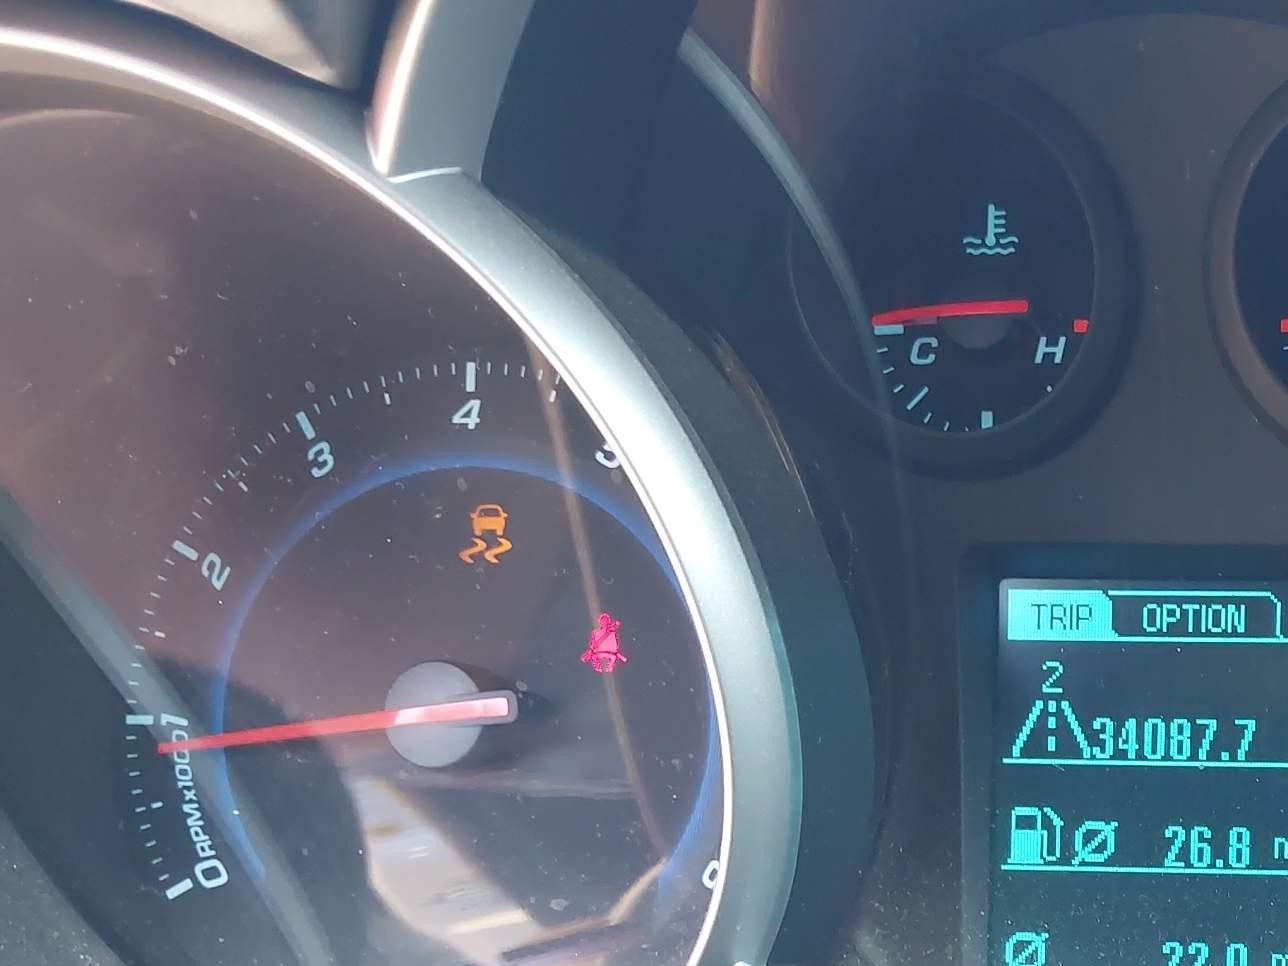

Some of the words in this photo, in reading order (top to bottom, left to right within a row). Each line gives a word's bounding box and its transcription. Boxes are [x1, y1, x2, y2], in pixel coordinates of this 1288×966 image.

[908, 337, 938, 364] C
[1035, 337, 1066, 363] H
[452, 400, 481, 429] 4
[307, 442, 334, 477] 3
[200, 552, 230, 590] 2
[1031, 603, 1093, 631] TRIP
[1142, 603, 1246, 632] OPTION
[1042, 661, 1064, 693] 2
[1092, 718, 1255, 760] 34087.7
[1164, 826, 1251, 868] 26.8
[194, 859, 229, 889] 0
